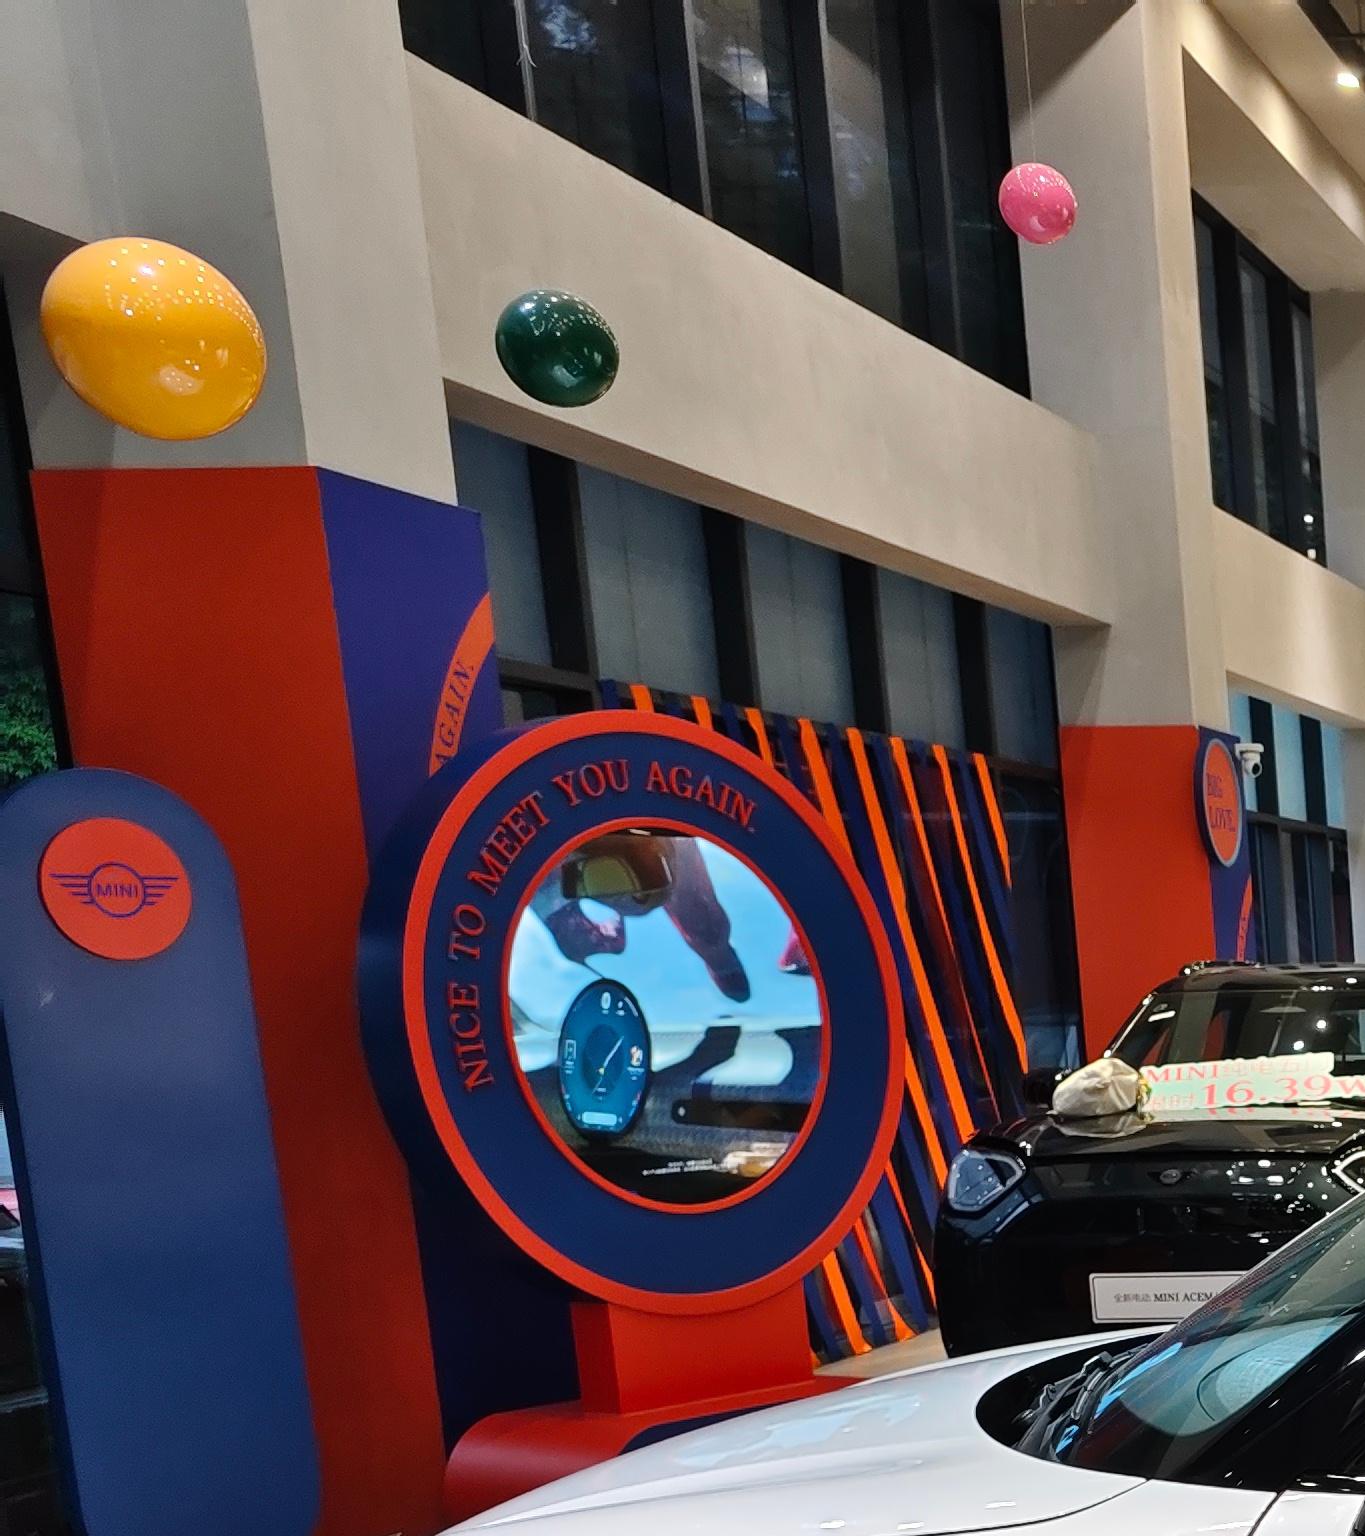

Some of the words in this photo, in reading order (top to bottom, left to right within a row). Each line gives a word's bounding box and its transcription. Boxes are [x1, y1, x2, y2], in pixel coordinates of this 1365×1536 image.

[551, 758, 630, 807] YOU
[1206, 773, 1223, 798] BIG
[466, 789, 551, 897] MEET
[96, 883, 139, 899] MINI
[449, 903, 487, 960] TO
[449, 982, 494, 1093] NICE
[1153, 1293, 1180, 1303] MINI
[1183, 1292, 1220, 1302] ACEM
